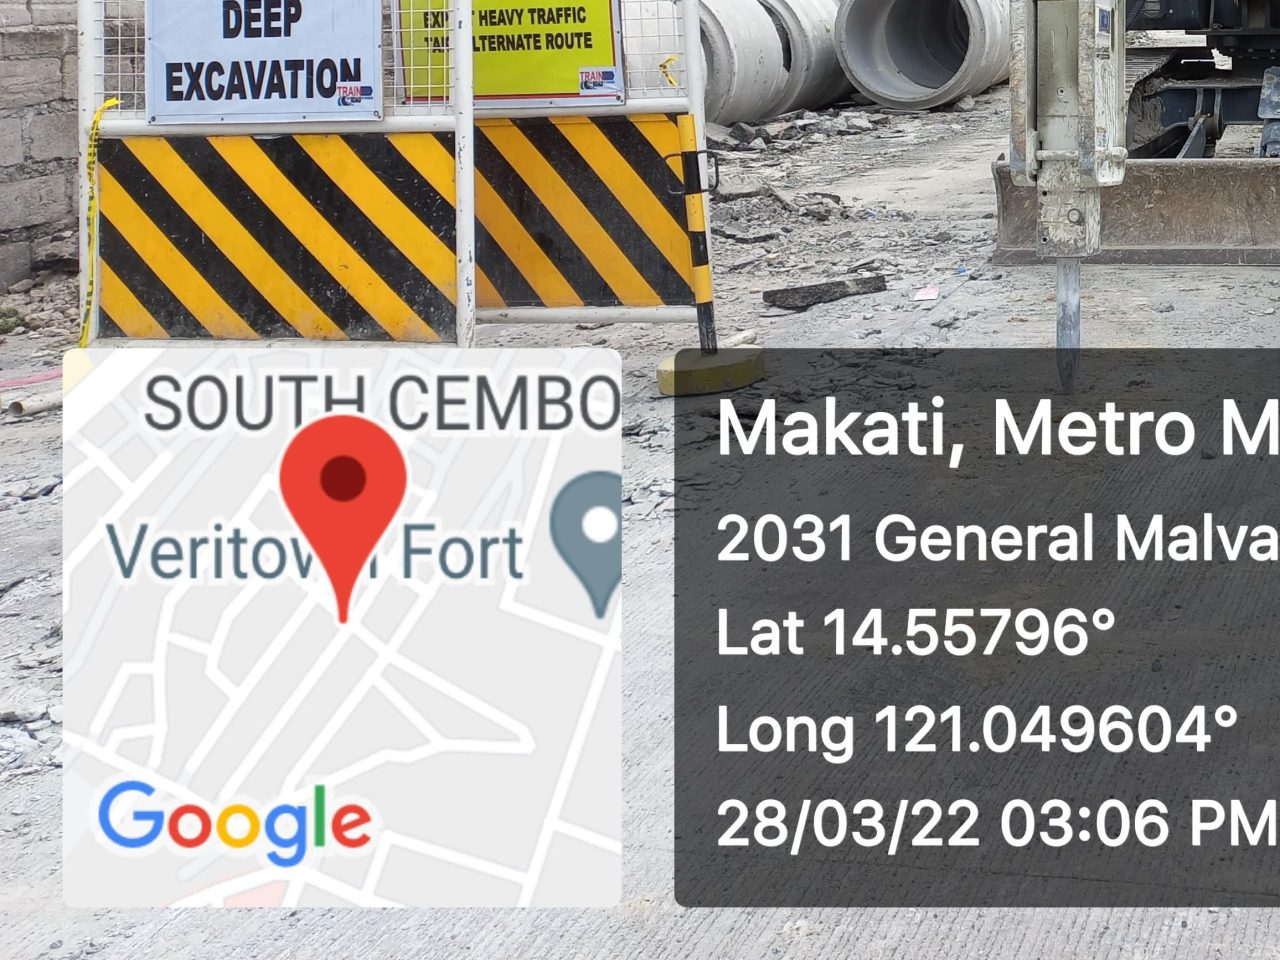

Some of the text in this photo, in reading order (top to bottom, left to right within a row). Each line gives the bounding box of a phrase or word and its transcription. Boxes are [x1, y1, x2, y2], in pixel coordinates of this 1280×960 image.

[479, 7, 524, 27] HEAVY
[528, 6, 587, 26] TRAFFIC
[472, 33, 541, 52] LTERNATE
[545, 32, 592, 50] ROUTE
[165, 57, 361, 103] EXCAVATION
